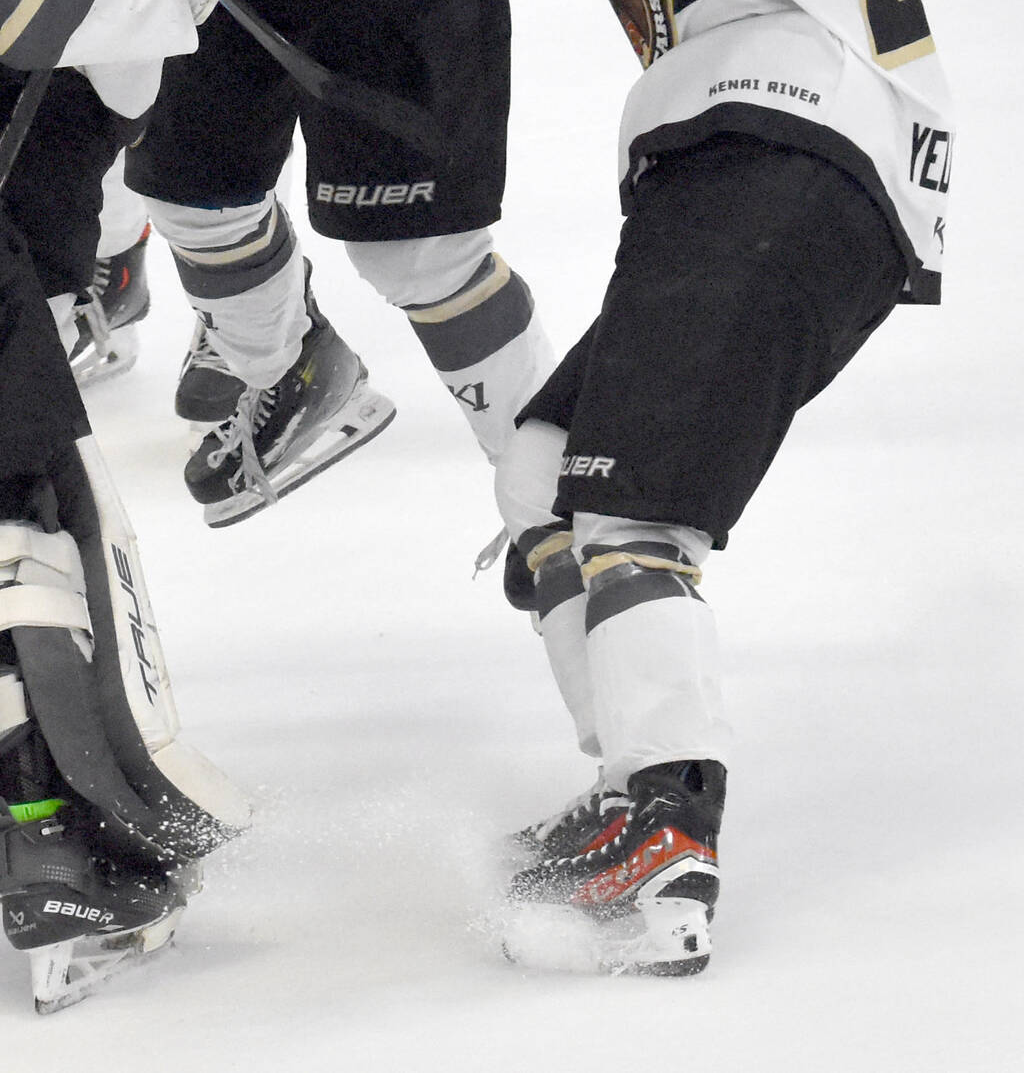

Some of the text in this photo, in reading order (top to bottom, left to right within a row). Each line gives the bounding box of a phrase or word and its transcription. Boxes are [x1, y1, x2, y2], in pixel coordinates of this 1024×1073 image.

[708, 78, 822, 106] KENAI RIVER
[315, 179, 437, 207] BAUER
[111, 542, 159, 707] TRUE
[43, 899, 116, 925] BAUER
